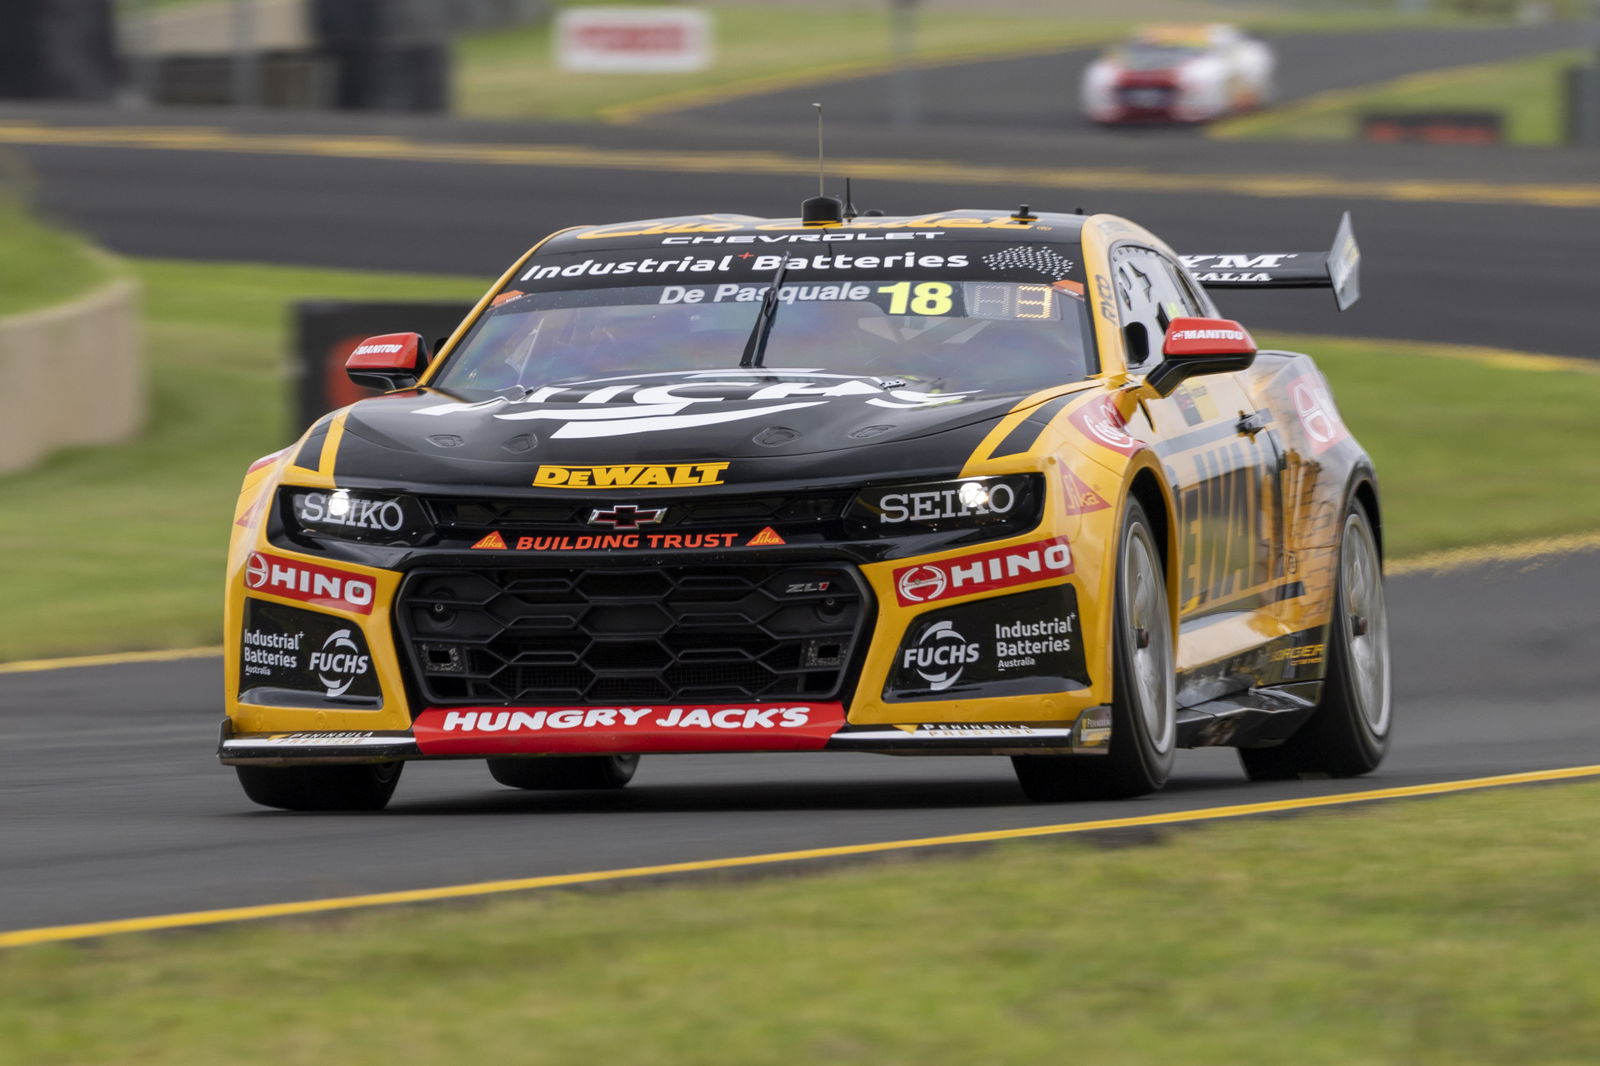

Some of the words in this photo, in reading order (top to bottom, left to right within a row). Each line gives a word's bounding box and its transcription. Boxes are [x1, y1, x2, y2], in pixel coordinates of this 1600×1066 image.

[661, 231, 946, 245] CHEVROLET
[519, 255, 734, 282] Industrial
[751, 251, 970, 272] Batteries
[658, 286, 705, 305] De
[713, 282, 871, 305] Pasquale
[877, 281, 953, 315] 18
[1183, 329, 1245, 341] MANITOU
[880, 483, 1015, 524] SEIKO
[477, 535, 504, 548] Sika
[516, 535, 640, 550] BUILDING
[647, 533, 739, 548] TRUST
[751, 531, 780, 545] Sika
[950, 543, 1072, 588] HINO
[270, 564, 373, 606] HINO
[785, 581, 830, 593] ZL1
[995, 614, 1073, 639] Industrial
[244, 629, 300, 650] Industrial
[996, 636, 1071, 657] Batteries
[244, 647, 297, 668] Batteries
[309, 652, 370, 675] FUCHS
[903, 643, 980, 669] FUCHS
[998, 656, 1036, 671] Australia
[245, 664, 272, 676] Australia
[442, 707, 653, 732] HUNGRY
[655, 705, 811, 730] JACK'S
[922, 723, 1033, 732] PENINSULA
[289, 731, 374, 740] PENINSULA
